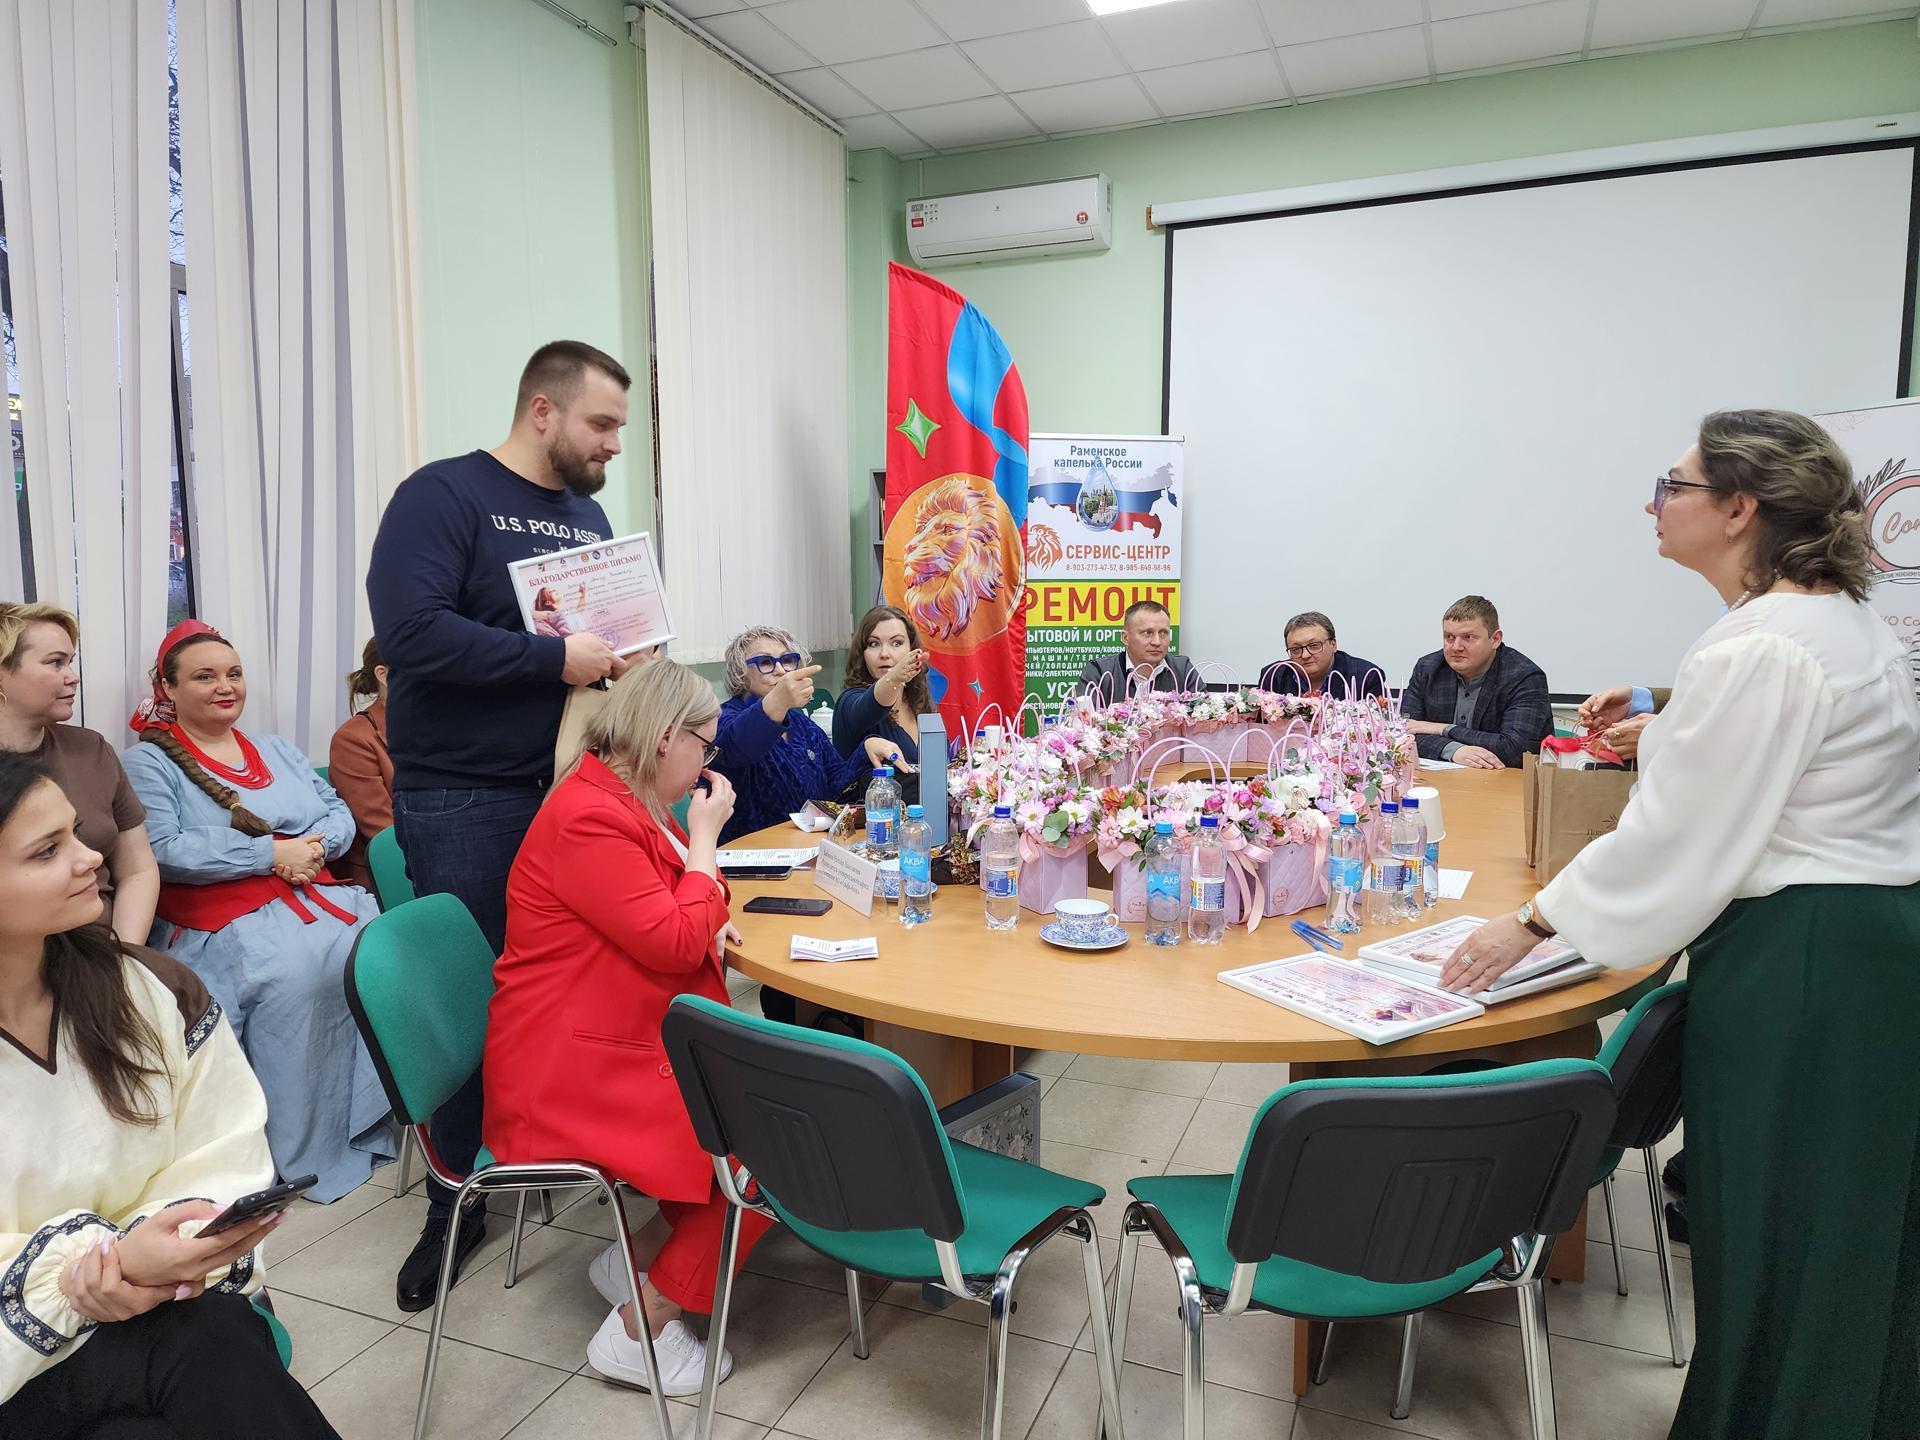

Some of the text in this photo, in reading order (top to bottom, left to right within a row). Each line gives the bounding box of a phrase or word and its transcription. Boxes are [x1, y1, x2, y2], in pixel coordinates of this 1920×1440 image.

[1070, 445, 1127, 457] Раменское
[1054, 457, 1142, 469] капелька России
[491, 514, 526, 533] U.S.
[527, 520, 571, 540] POLO
[1066, 545, 1171, 561] СЕРВИС-ЦЕНТР
[528, 560, 610, 588] БЛАГОДАРСТВЕННОЕ
[610, 553, 642, 568] ПИСЬМО
[1026, 627, 1080, 643] ЫТОВОЙ
[1083, 629, 1092, 643] И
[1046, 681, 1079, 699] УСТ
[903, 856, 925, 865] АКВА
